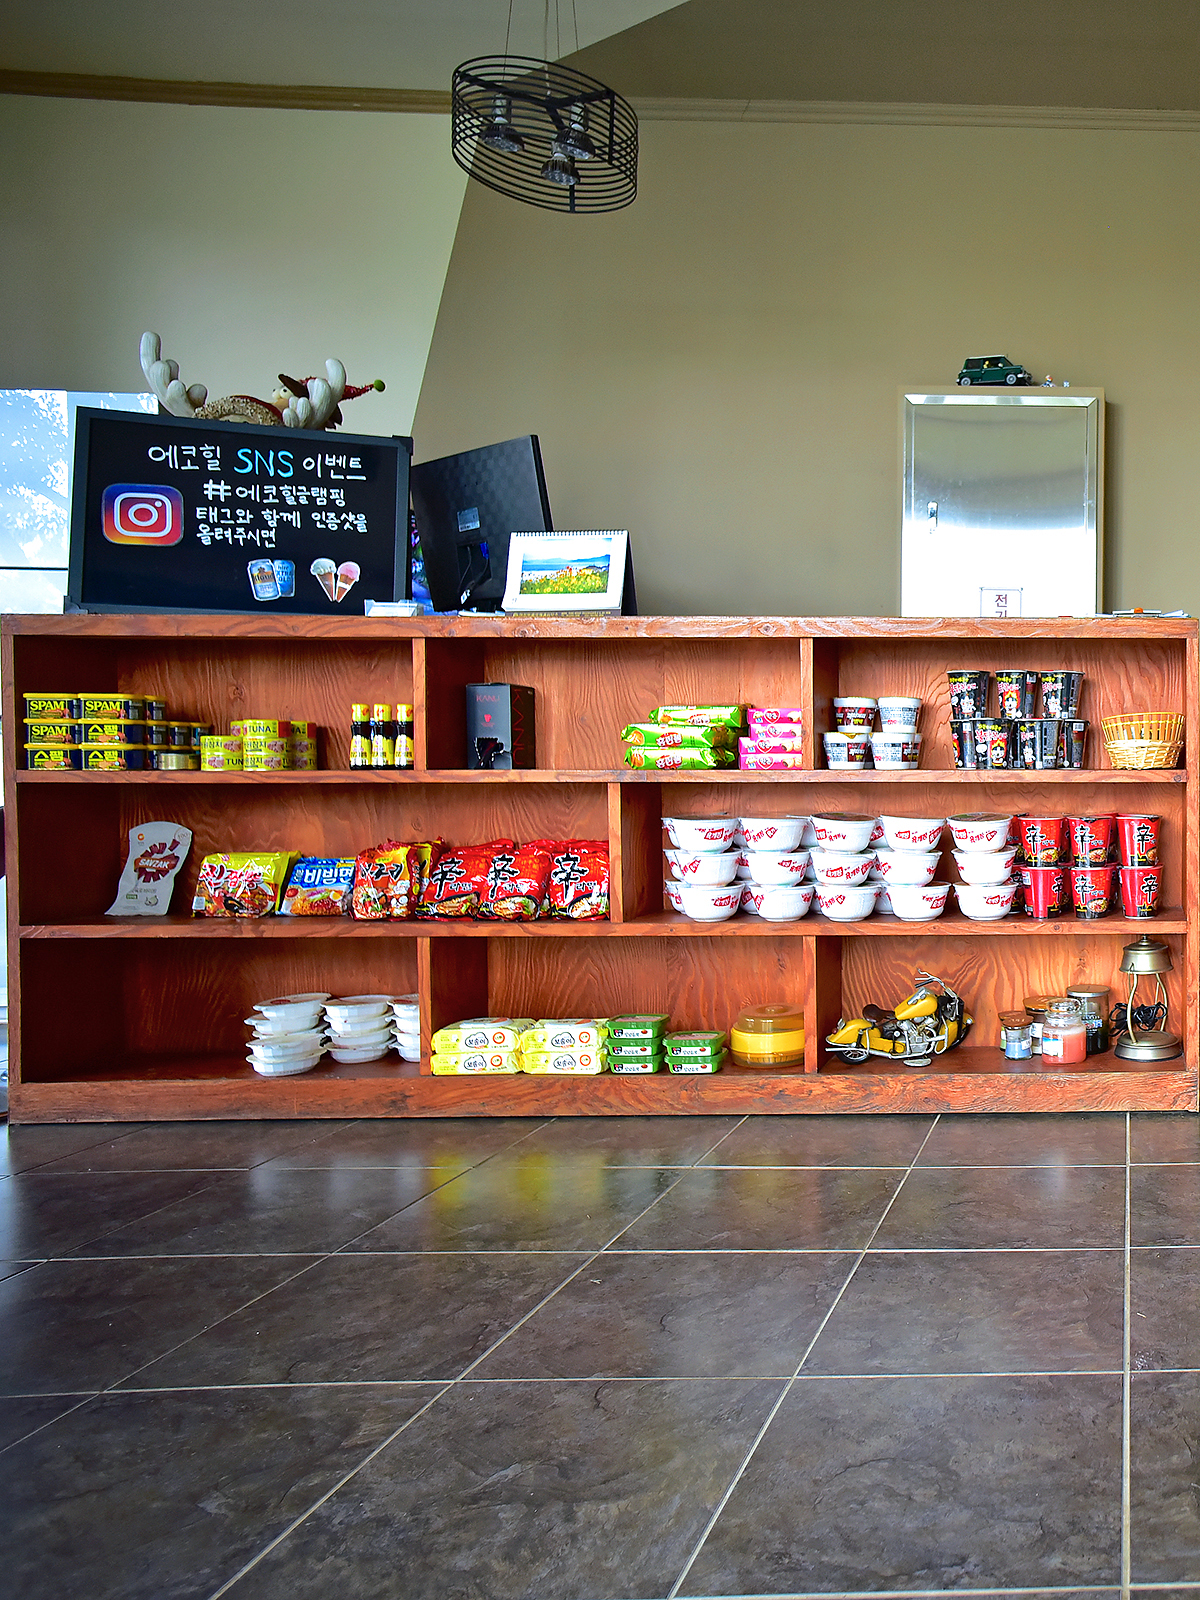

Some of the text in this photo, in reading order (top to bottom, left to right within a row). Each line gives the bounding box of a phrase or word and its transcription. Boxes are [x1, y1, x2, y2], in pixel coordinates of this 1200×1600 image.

[148, 443, 367, 481] 에코힐 SNS 이벤트
[196, 506, 368, 533] 태그와 함께 인증샷을
[196, 523, 276, 549] 올려주시면
[29, 700, 65, 711] SPAM
[85, 700, 121, 711] SPAM
[476, 694, 500, 702] KANU
[31, 725, 67, 736] SPAM
[248, 725, 272, 733] TUNA
[511, 688, 525, 765] KANU
[226, 758, 244, 766] TUN
[304, 867, 355, 885] 비빔면
[430, 857, 467, 899] 辛
[486, 853, 520, 900] 辛
[551, 853, 589, 900] 辛
